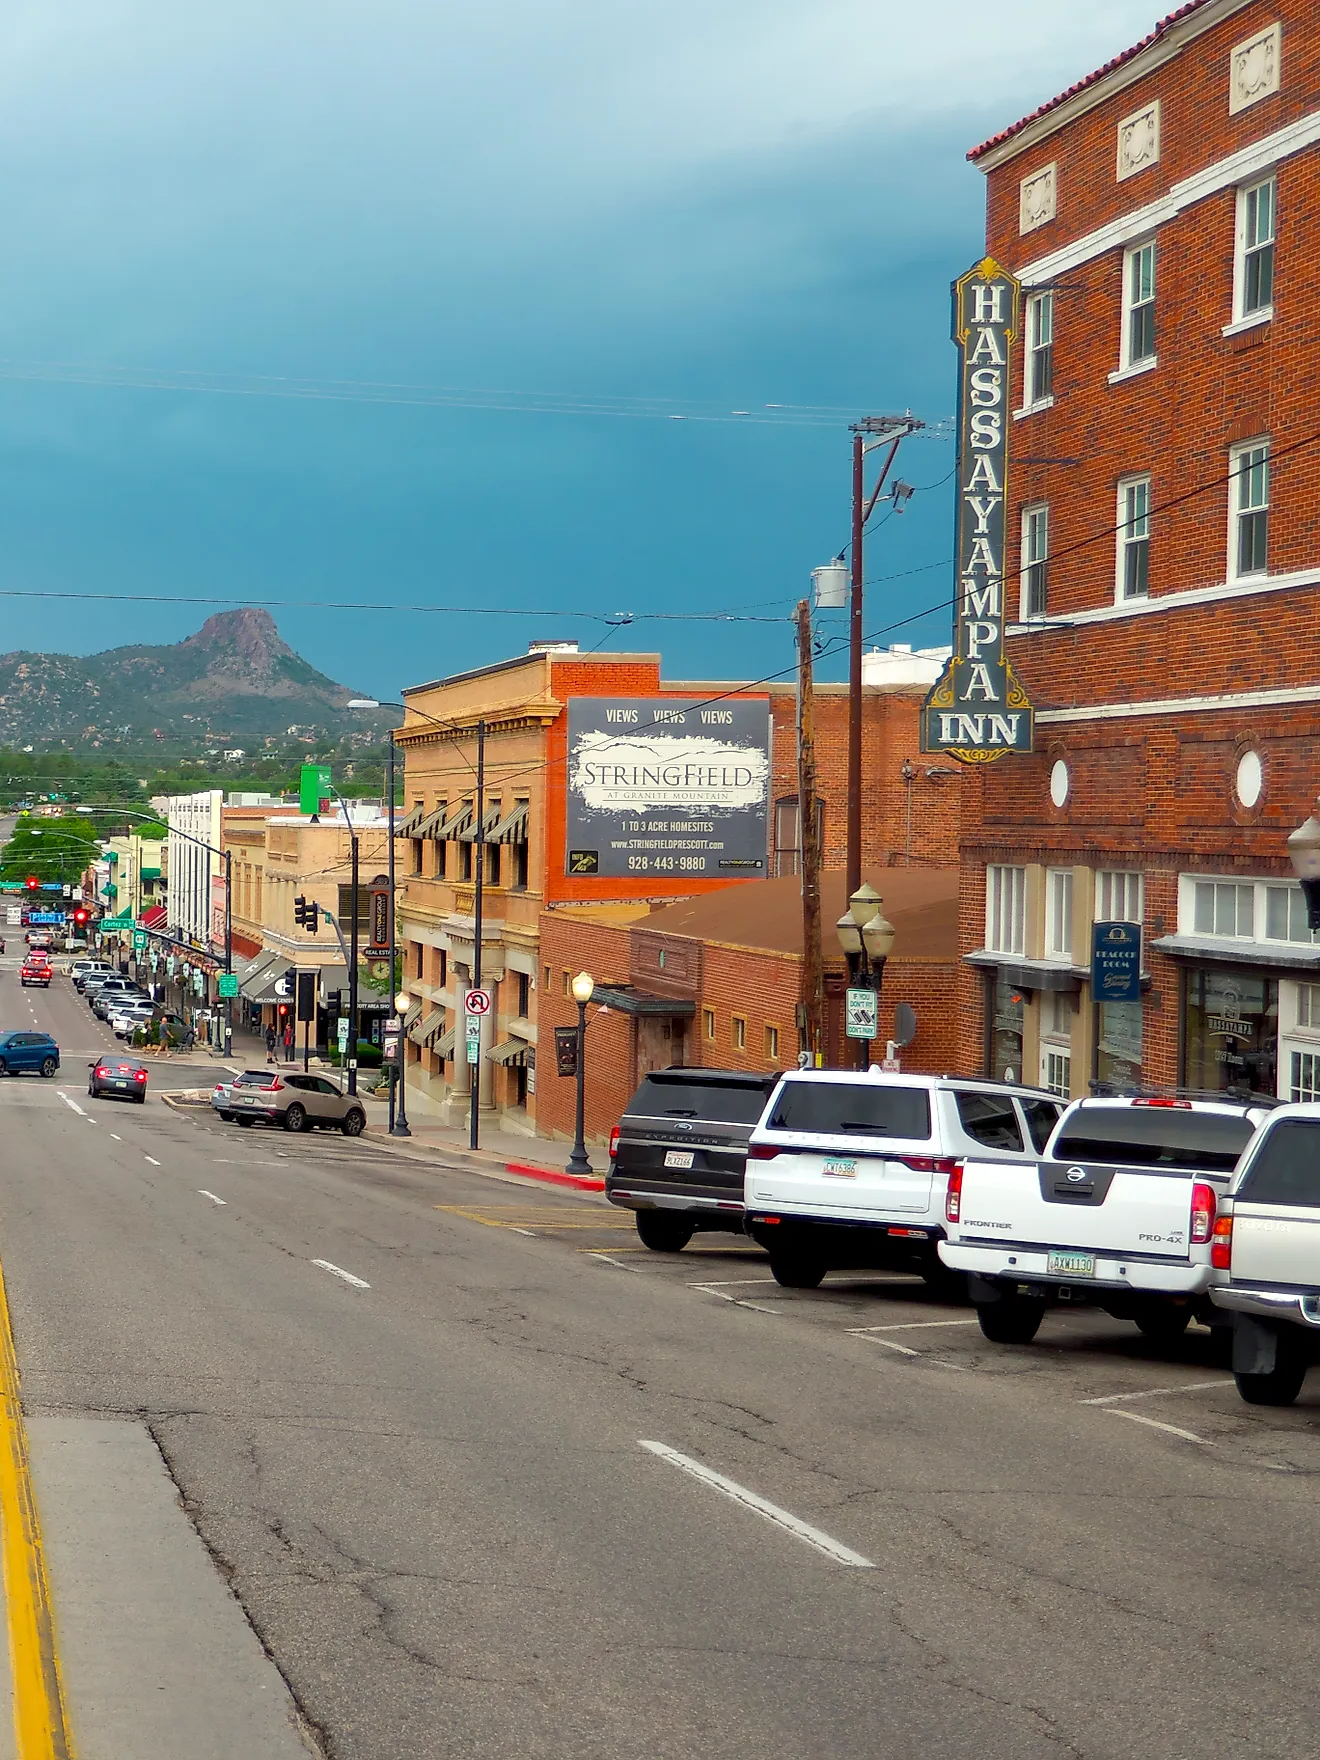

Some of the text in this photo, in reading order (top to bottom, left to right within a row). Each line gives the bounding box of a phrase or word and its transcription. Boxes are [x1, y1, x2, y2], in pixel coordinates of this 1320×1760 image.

[961, 284, 1006, 702] HASSAYAMPA
[606, 709, 733, 724] VIEWS VIEWS VIEWS
[937, 712, 1020, 745] INN
[584, 762, 752, 787] STRINGFIELD
[623, 792, 668, 800] GRANITE
[621, 821, 714, 832] 1 TO 3 ACRE HOMESITES
[611, 839, 724, 850] www.STRINGFIELDPRESCOTT.com
[1096, 951, 1136, 959] PEACOCK
[645, 1134, 719, 1145] EXPEDITION
[963, 1219, 1012, 1230] FRONTIER
[1239, 1218, 1291, 1232] TOYOTA
[1138, 1233, 1183, 1245] PRO-4X
[1053, 1255, 1093, 1274] AXW1130
